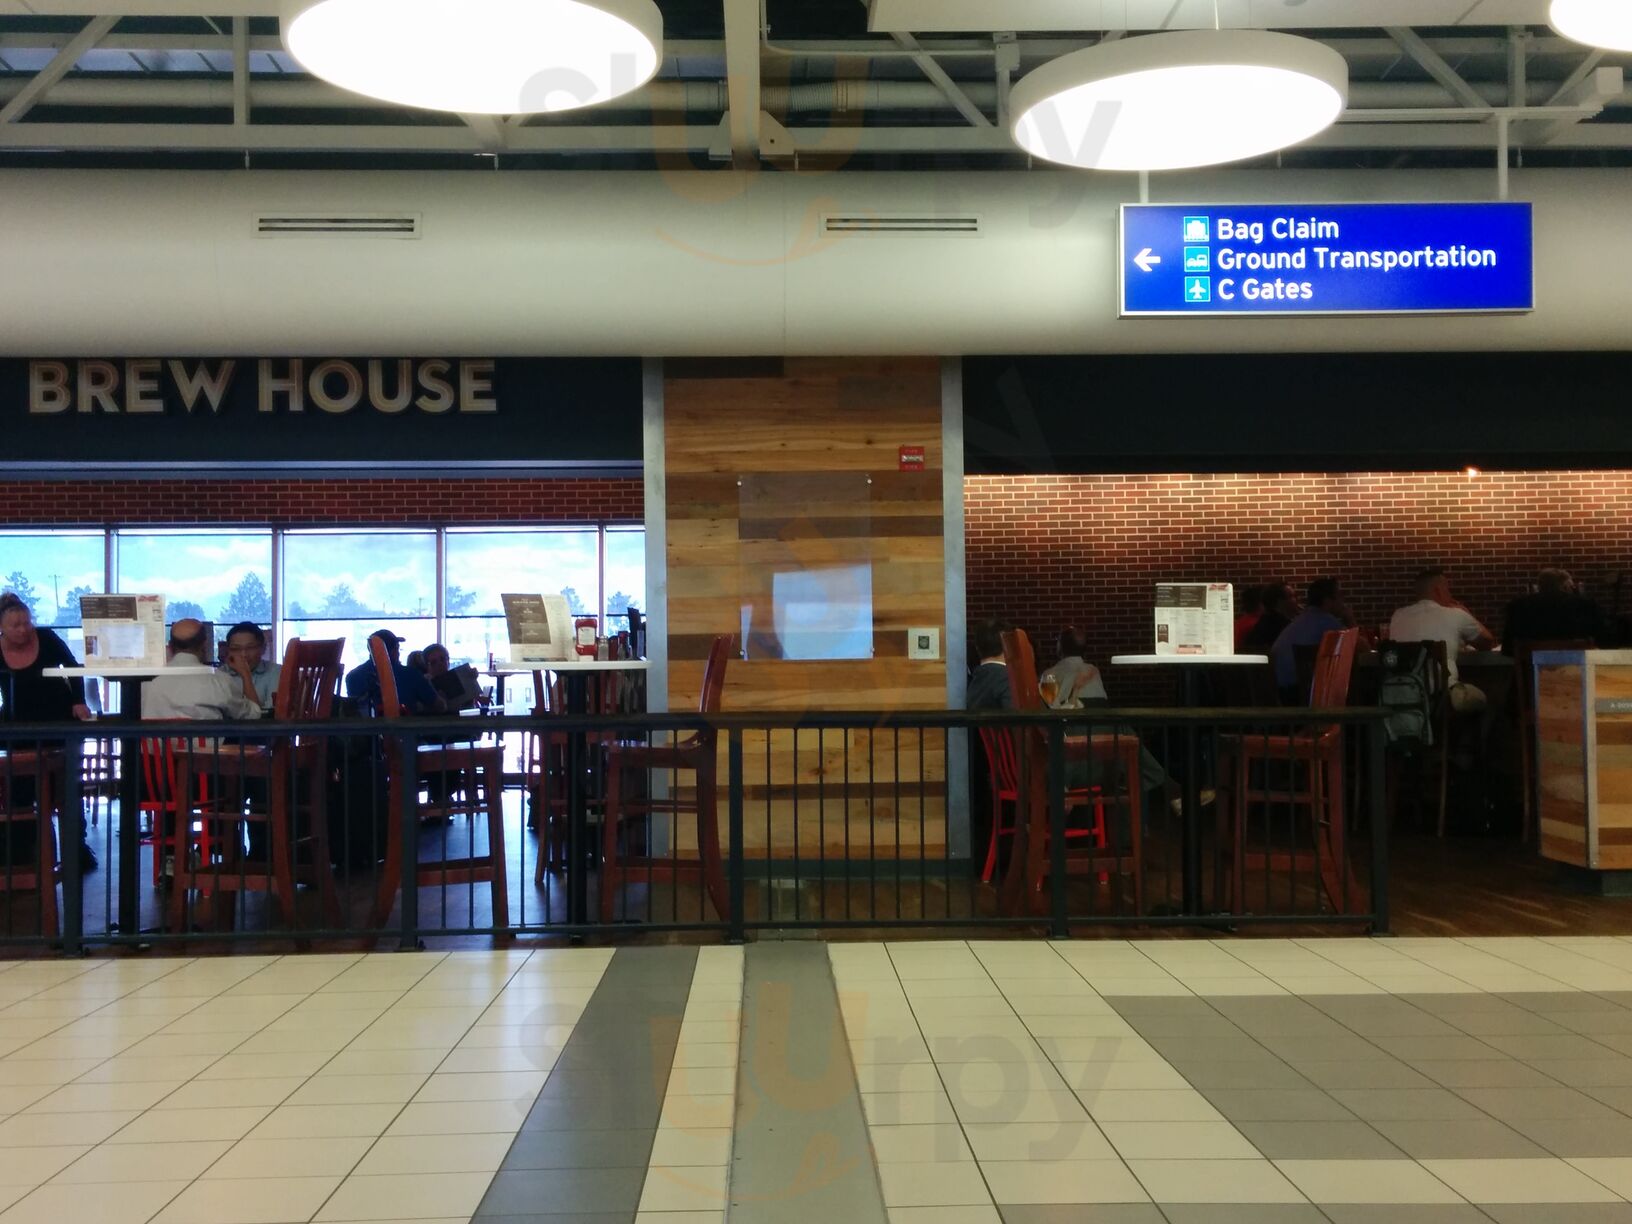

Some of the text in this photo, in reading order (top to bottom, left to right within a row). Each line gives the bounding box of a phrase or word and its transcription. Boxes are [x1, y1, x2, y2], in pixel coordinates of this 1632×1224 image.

[1217, 217, 1339, 242] Bag Claim
[1217, 246, 1496, 272] Ground Transportation
[1218, 278, 1313, 300] C Gates
[29, 359, 497, 413] BREW HOUSE
